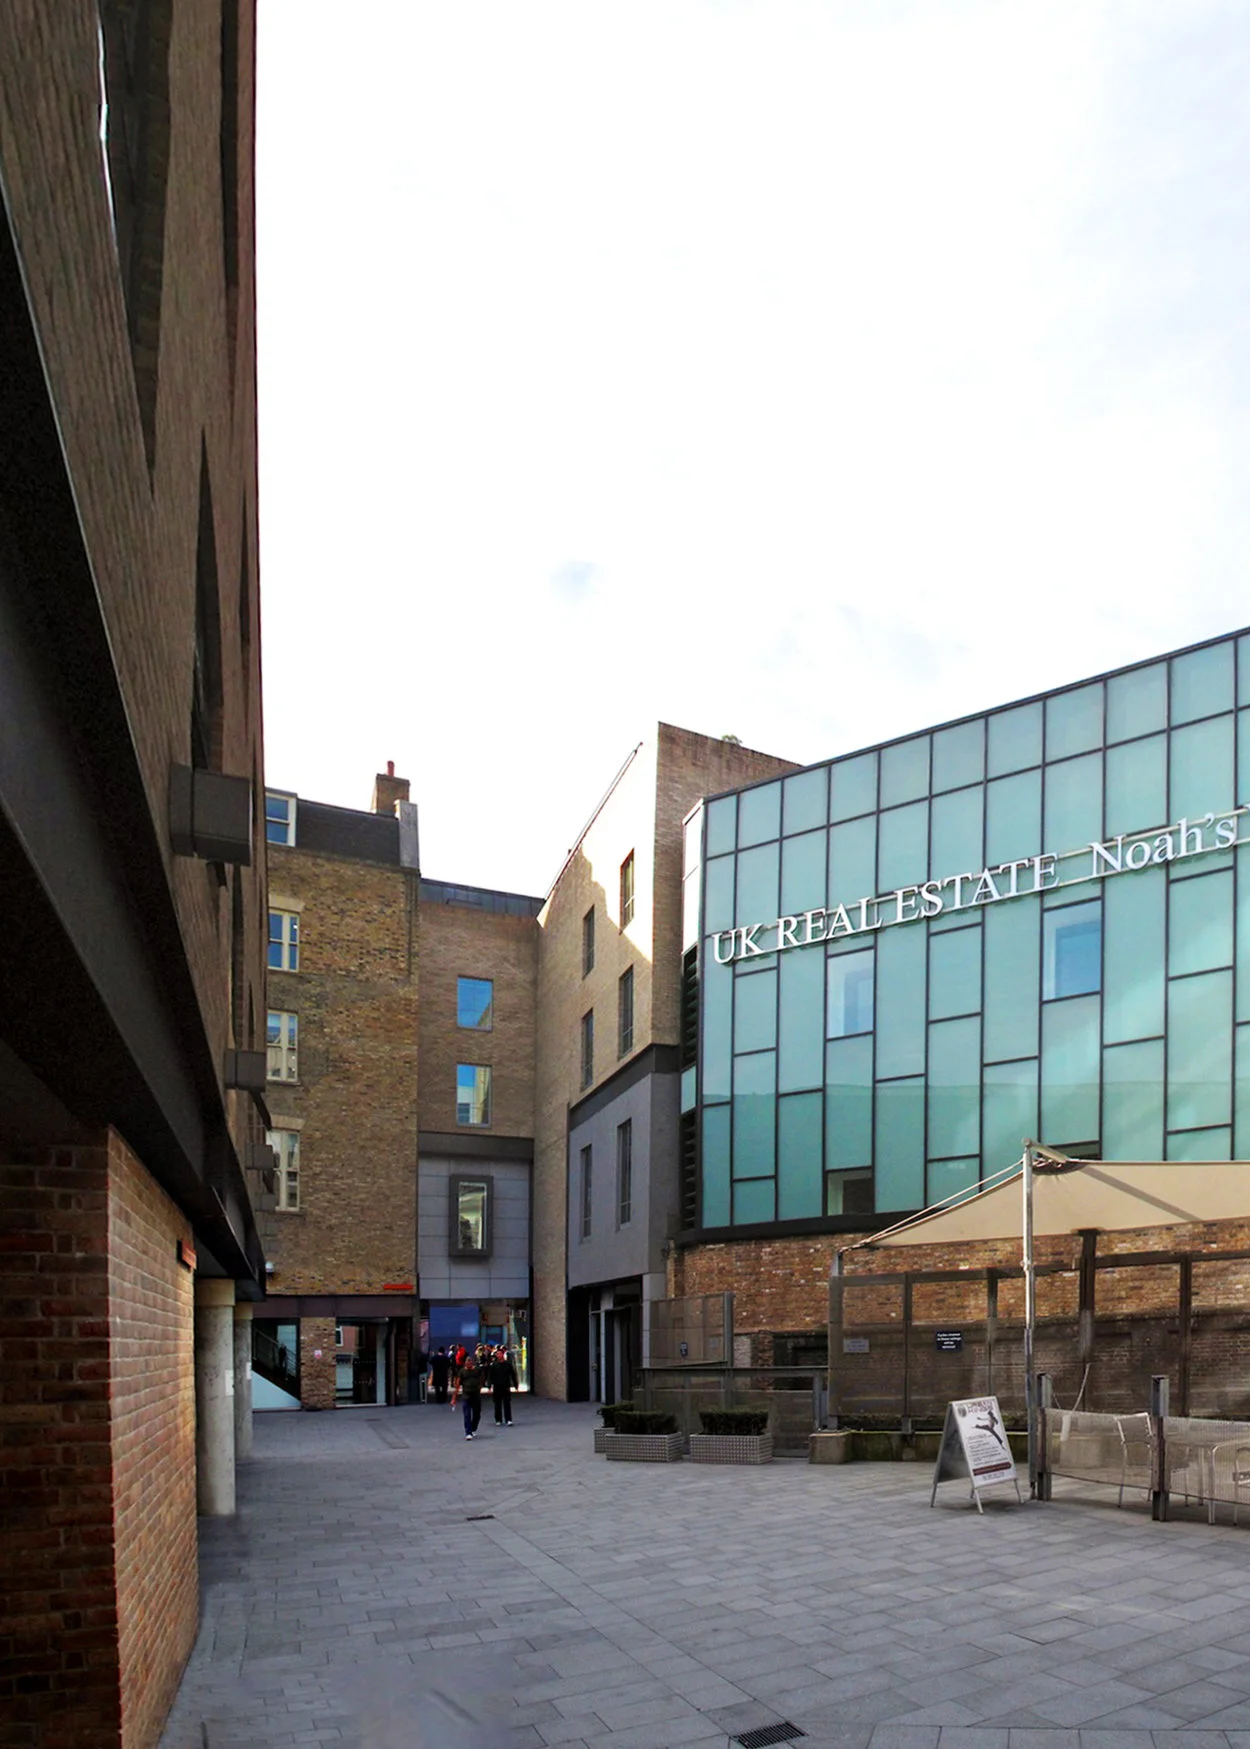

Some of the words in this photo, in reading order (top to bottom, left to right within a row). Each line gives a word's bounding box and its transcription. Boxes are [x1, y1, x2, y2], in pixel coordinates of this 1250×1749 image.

[711, 922, 767, 965] UK
[776, 896, 883, 950] REAL
[893, 852, 1060, 924] ESTATE
[1088, 811, 1238, 879] Noah's
